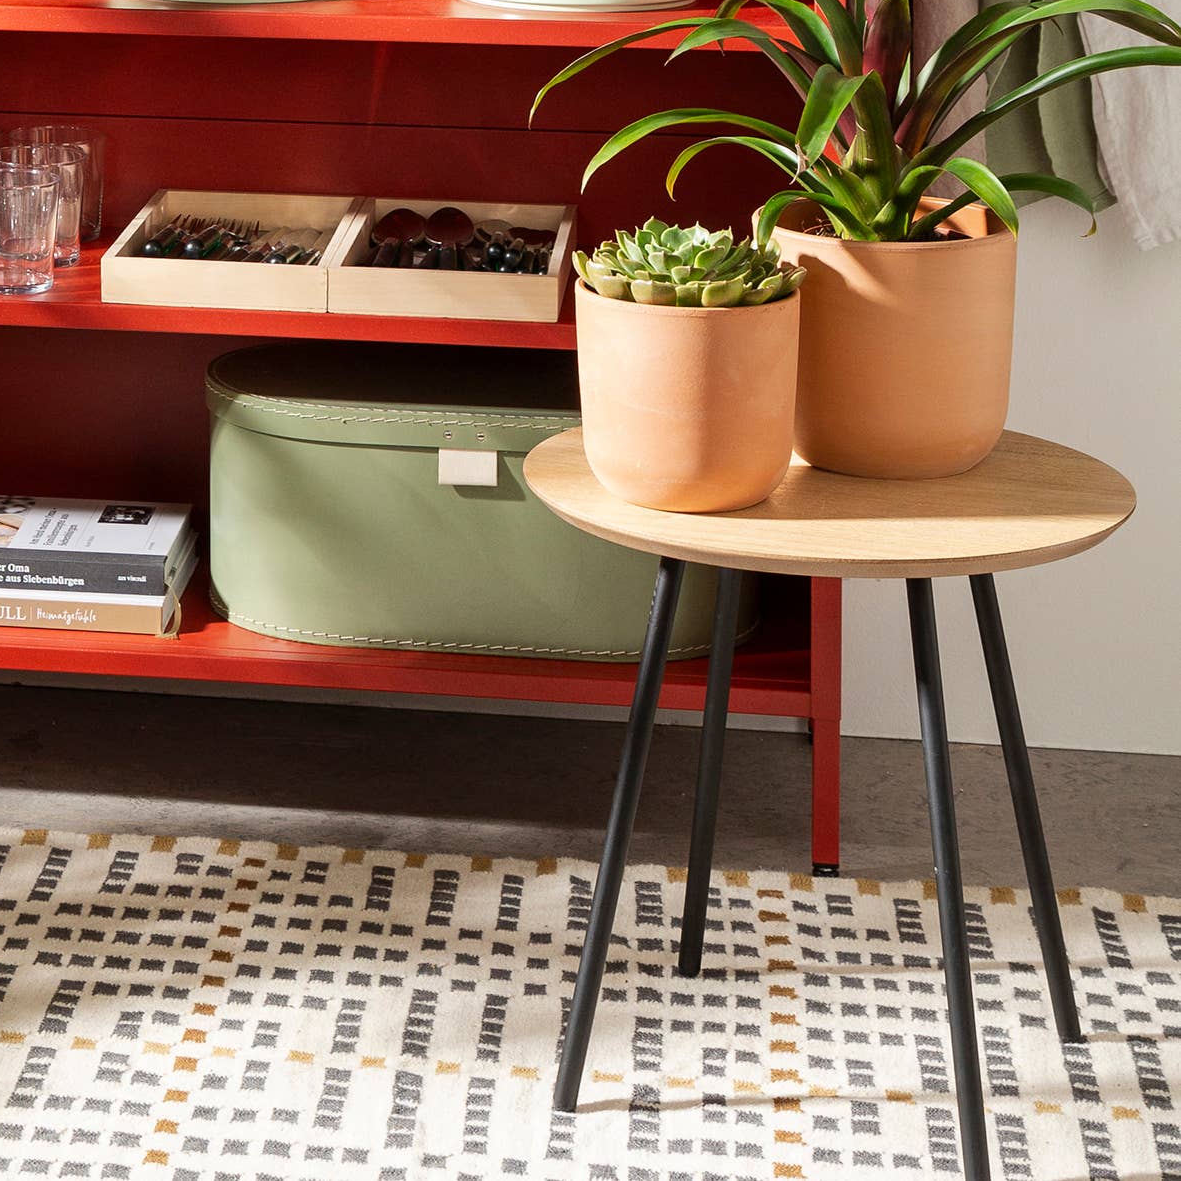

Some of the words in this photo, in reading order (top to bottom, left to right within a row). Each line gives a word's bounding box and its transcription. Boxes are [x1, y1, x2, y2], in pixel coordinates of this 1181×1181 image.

[8, 563, 30, 573] Oma
[5, 575, 21, 583] aus
[23, 575, 84, 586] Siebenbürgen
